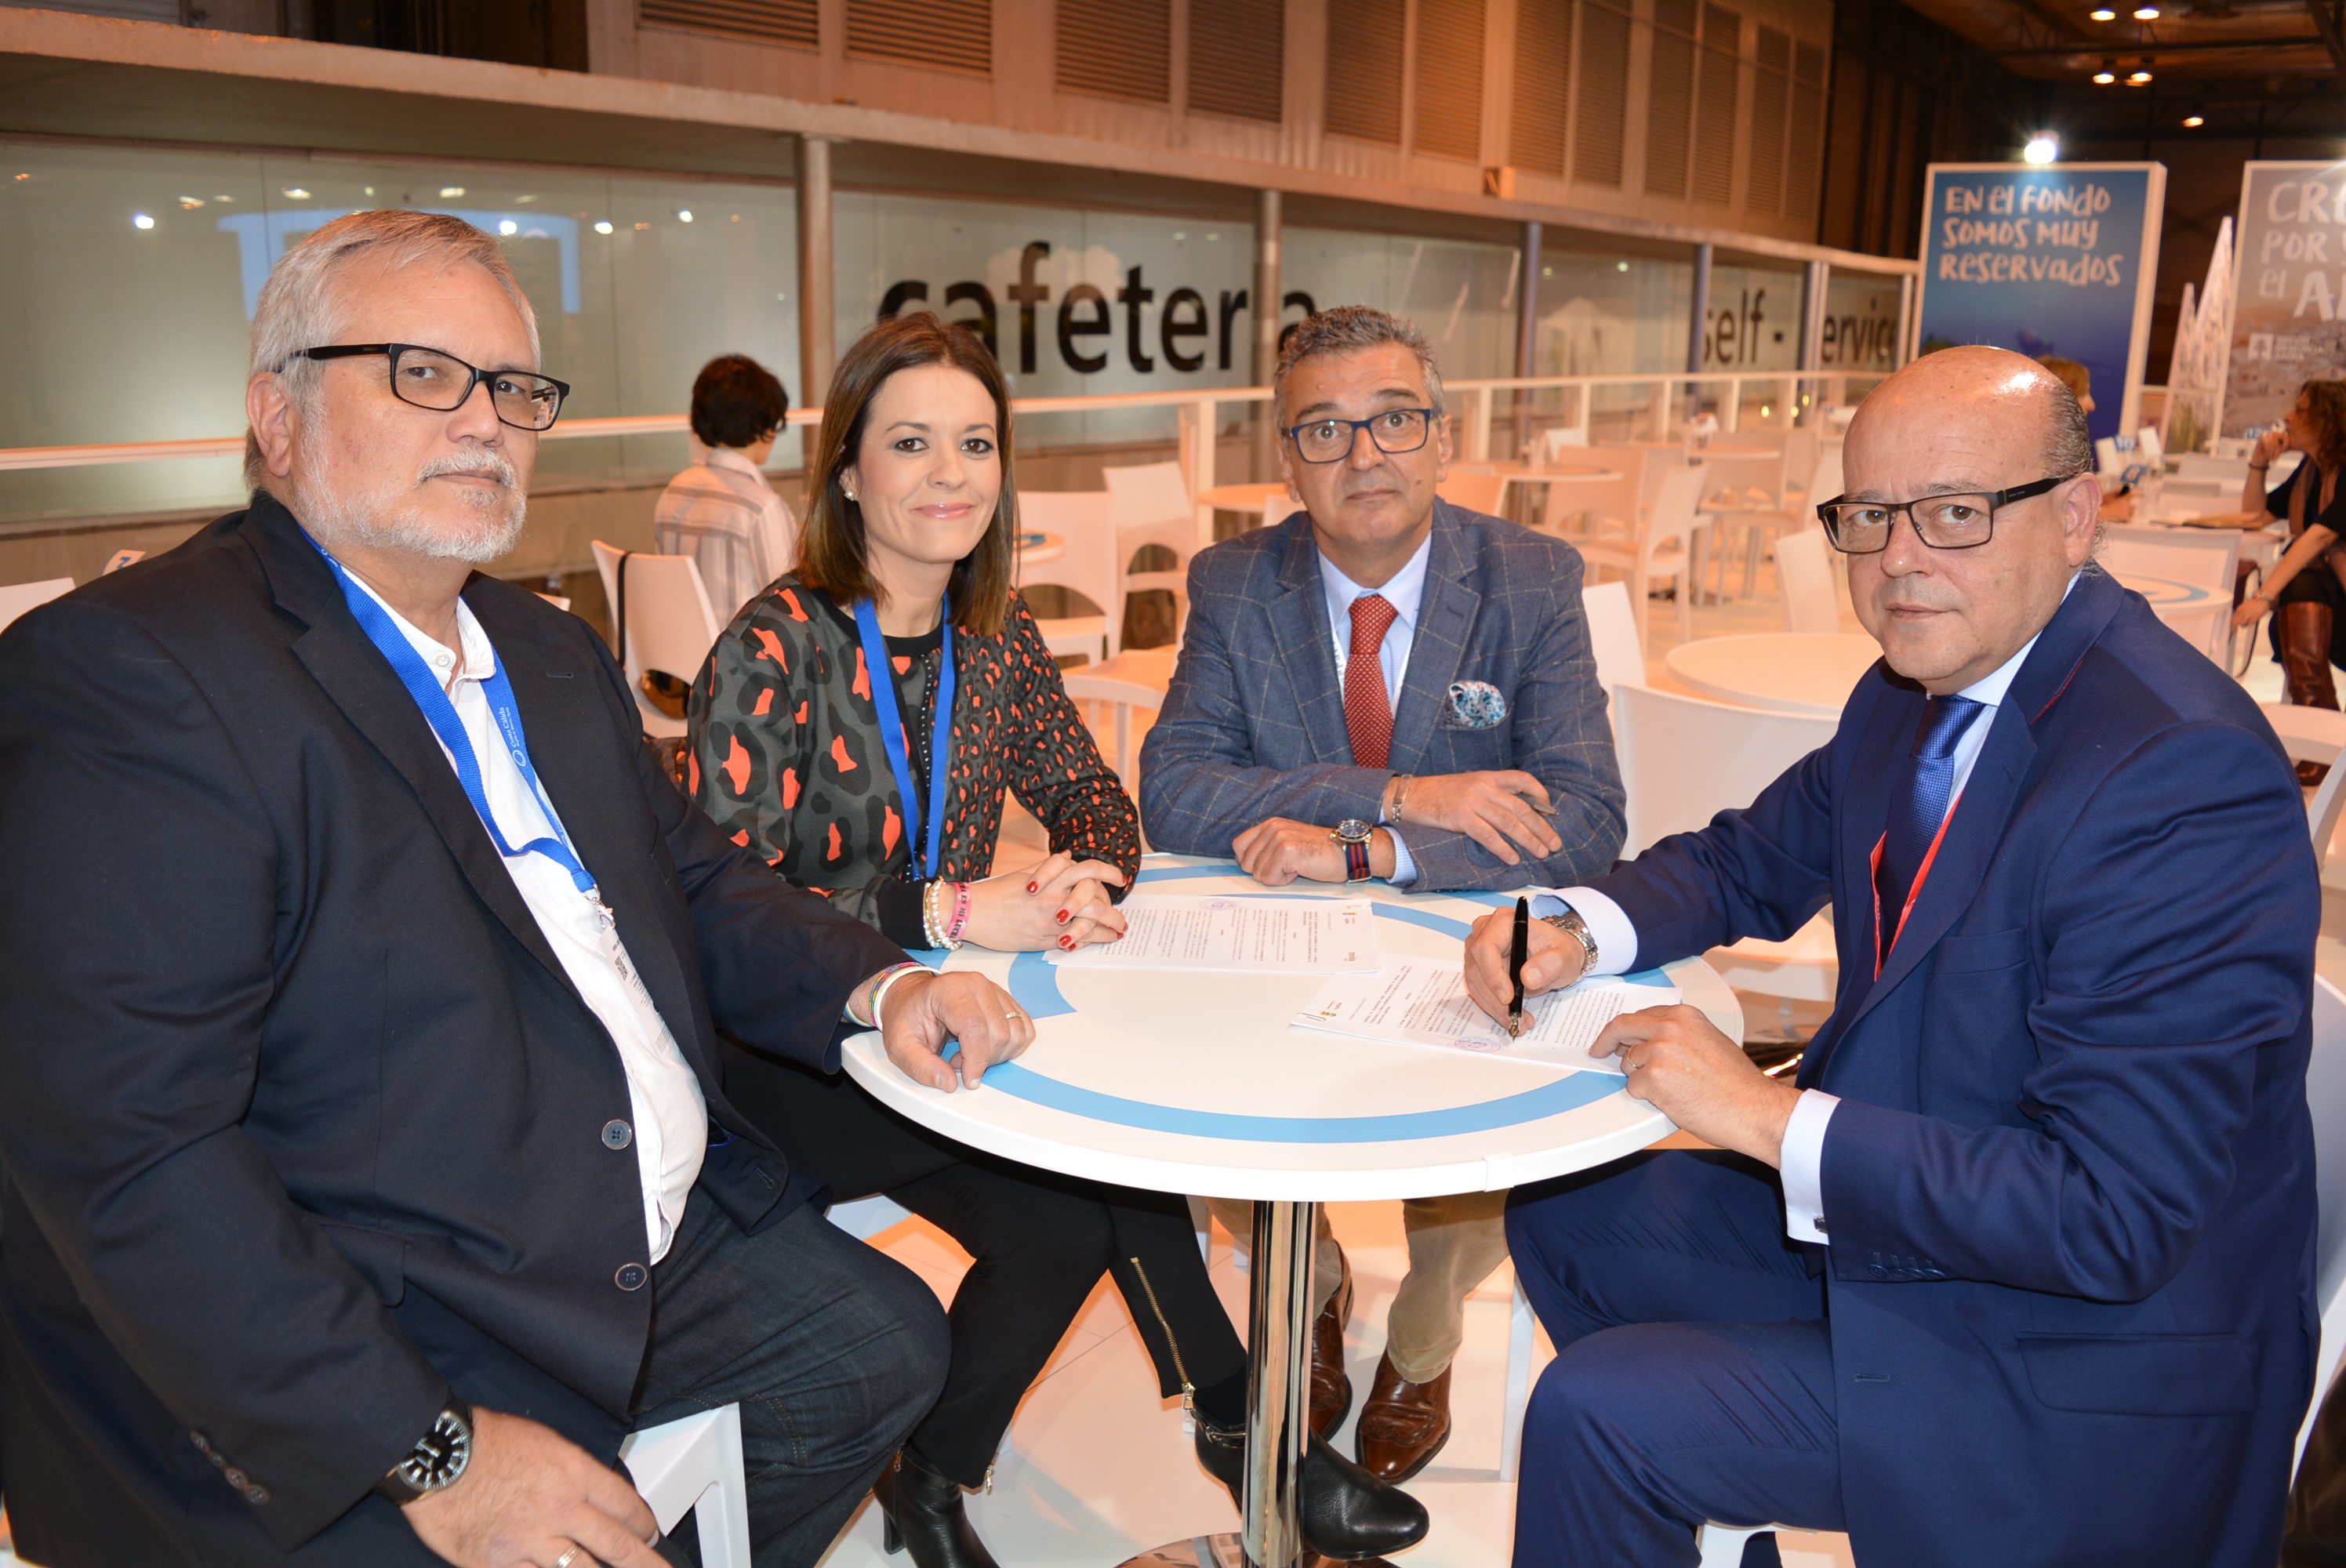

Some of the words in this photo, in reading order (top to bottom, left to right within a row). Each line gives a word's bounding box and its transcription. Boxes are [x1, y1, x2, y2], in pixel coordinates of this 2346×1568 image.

[1945, 186, 1984, 214] EN
[1942, 216, 2032, 250] SOMOS
[2261, 230, 2329, 264] POR
[958, 907, 966, 917] MI
[961, 895, 968, 905] ES
